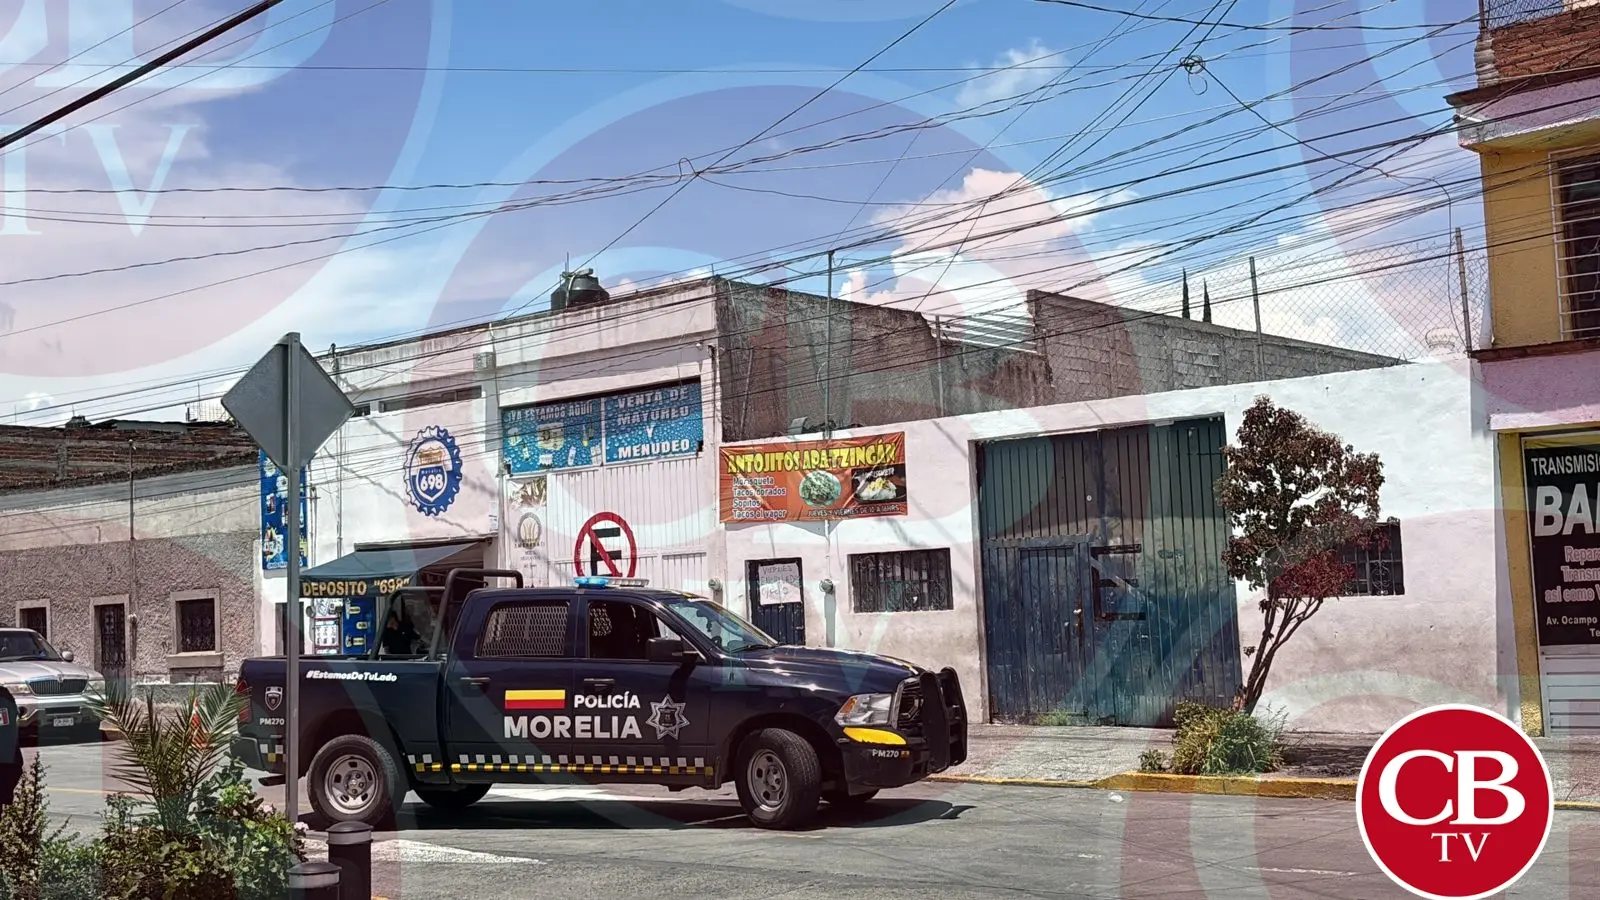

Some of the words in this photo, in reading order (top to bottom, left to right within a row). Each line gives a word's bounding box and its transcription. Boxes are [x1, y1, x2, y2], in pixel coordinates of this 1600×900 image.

[618, 391, 662, 408] VENTA
[669, 387, 688, 401] DE
[525, 405, 566, 420] ESTAMOS
[618, 406, 689, 425] MAYOREO
[646, 424, 656, 439] Y
[618, 439, 690, 459] MENUDEO
[728, 449, 800, 474] ANTOJITOS
[1531, 453, 1600, 476] TRANSMISI
[420, 473, 444, 491] 698
[733, 476, 775, 487] Morisqueta
[733, 488, 754, 496] Tacos
[756, 486, 786, 496] dorados
[733, 498, 760, 509] Sopitos
[1535, 482, 1600, 537] BA
[733, 509, 755, 518] Tacos
[764, 510, 786, 520] vapor
[302, 581, 367, 596] DEPOSITO
[1563, 588, 1595, 602] como
[1546, 616, 1559, 626] Av.
[1561, 616, 1598, 626] Ocampo
[306, 670, 398, 682] #EstamosDeTuLado
[574, 691, 641, 709] POLICÍA
[259, 717, 285, 726] PM270
[504, 715, 643, 739] MORELIA
[872, 748, 900, 758] PM270
